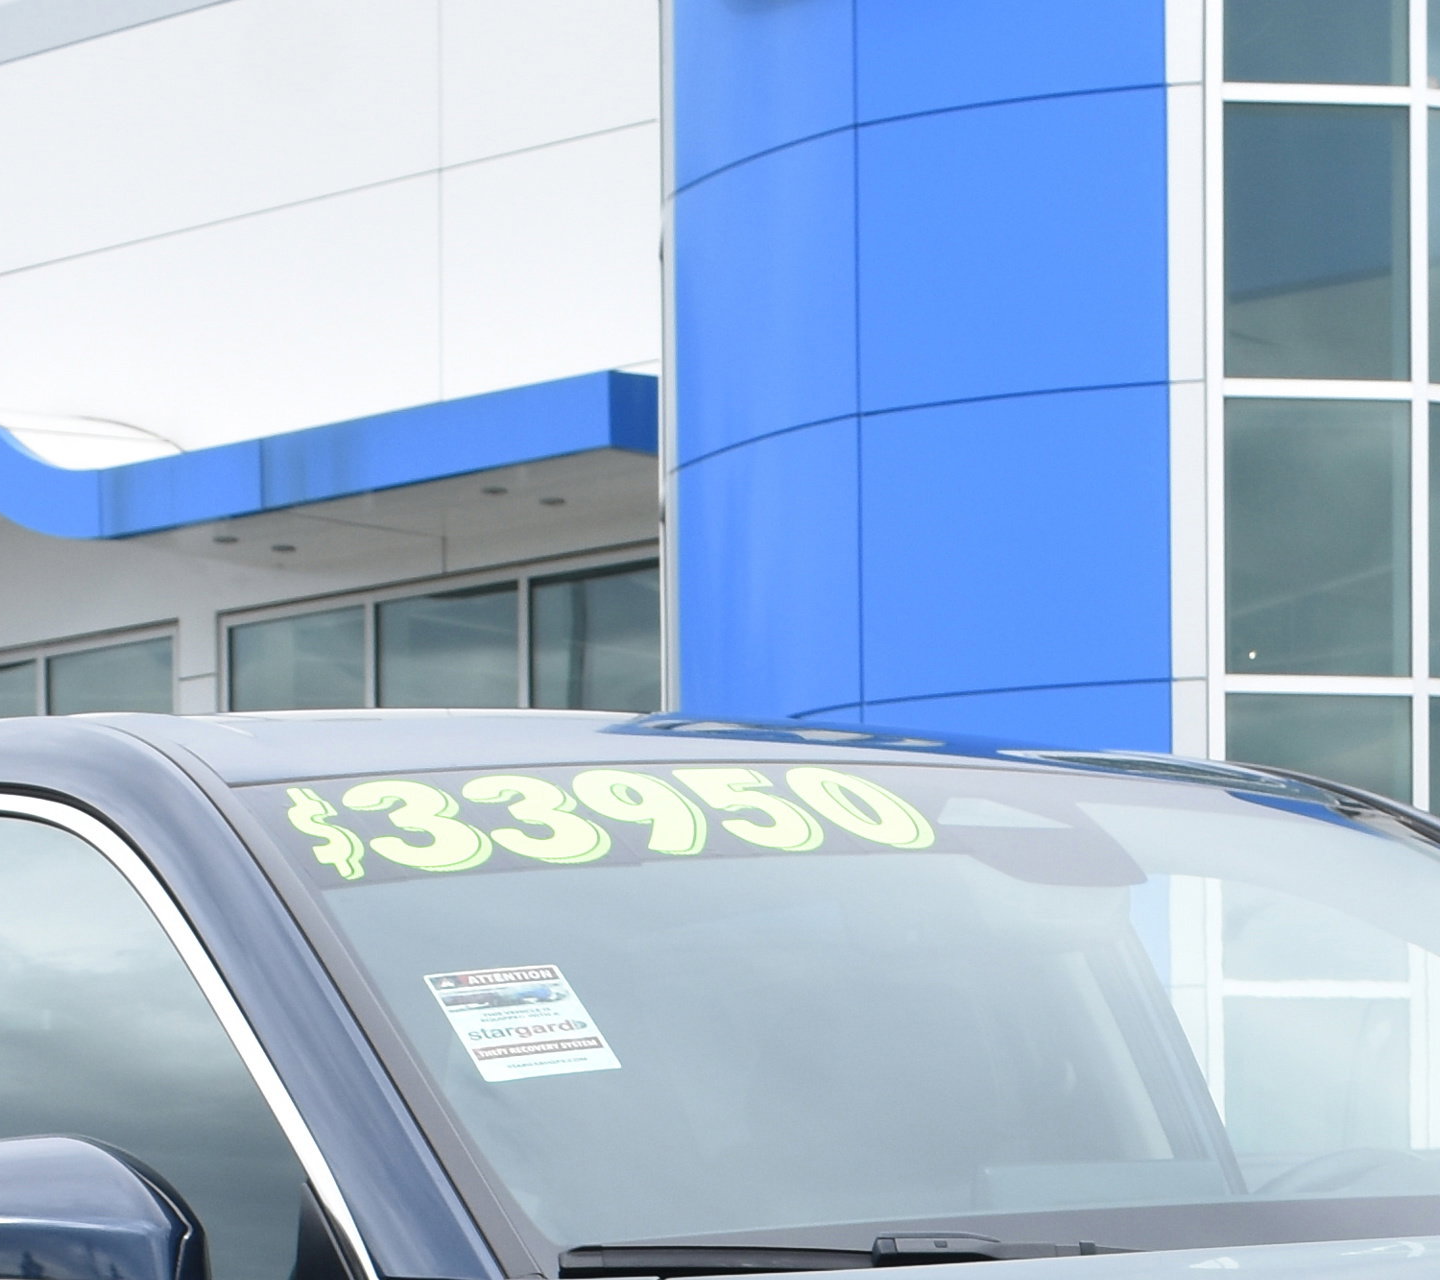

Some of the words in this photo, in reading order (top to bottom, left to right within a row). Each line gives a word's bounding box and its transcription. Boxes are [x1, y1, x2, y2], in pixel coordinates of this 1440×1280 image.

[287, 767, 935, 880] $33950
[467, 968, 554, 986] ATTENTION
[510, 1042, 560, 1056] RECOVERY
[560, 1038, 599, 1050] SYSTEM
